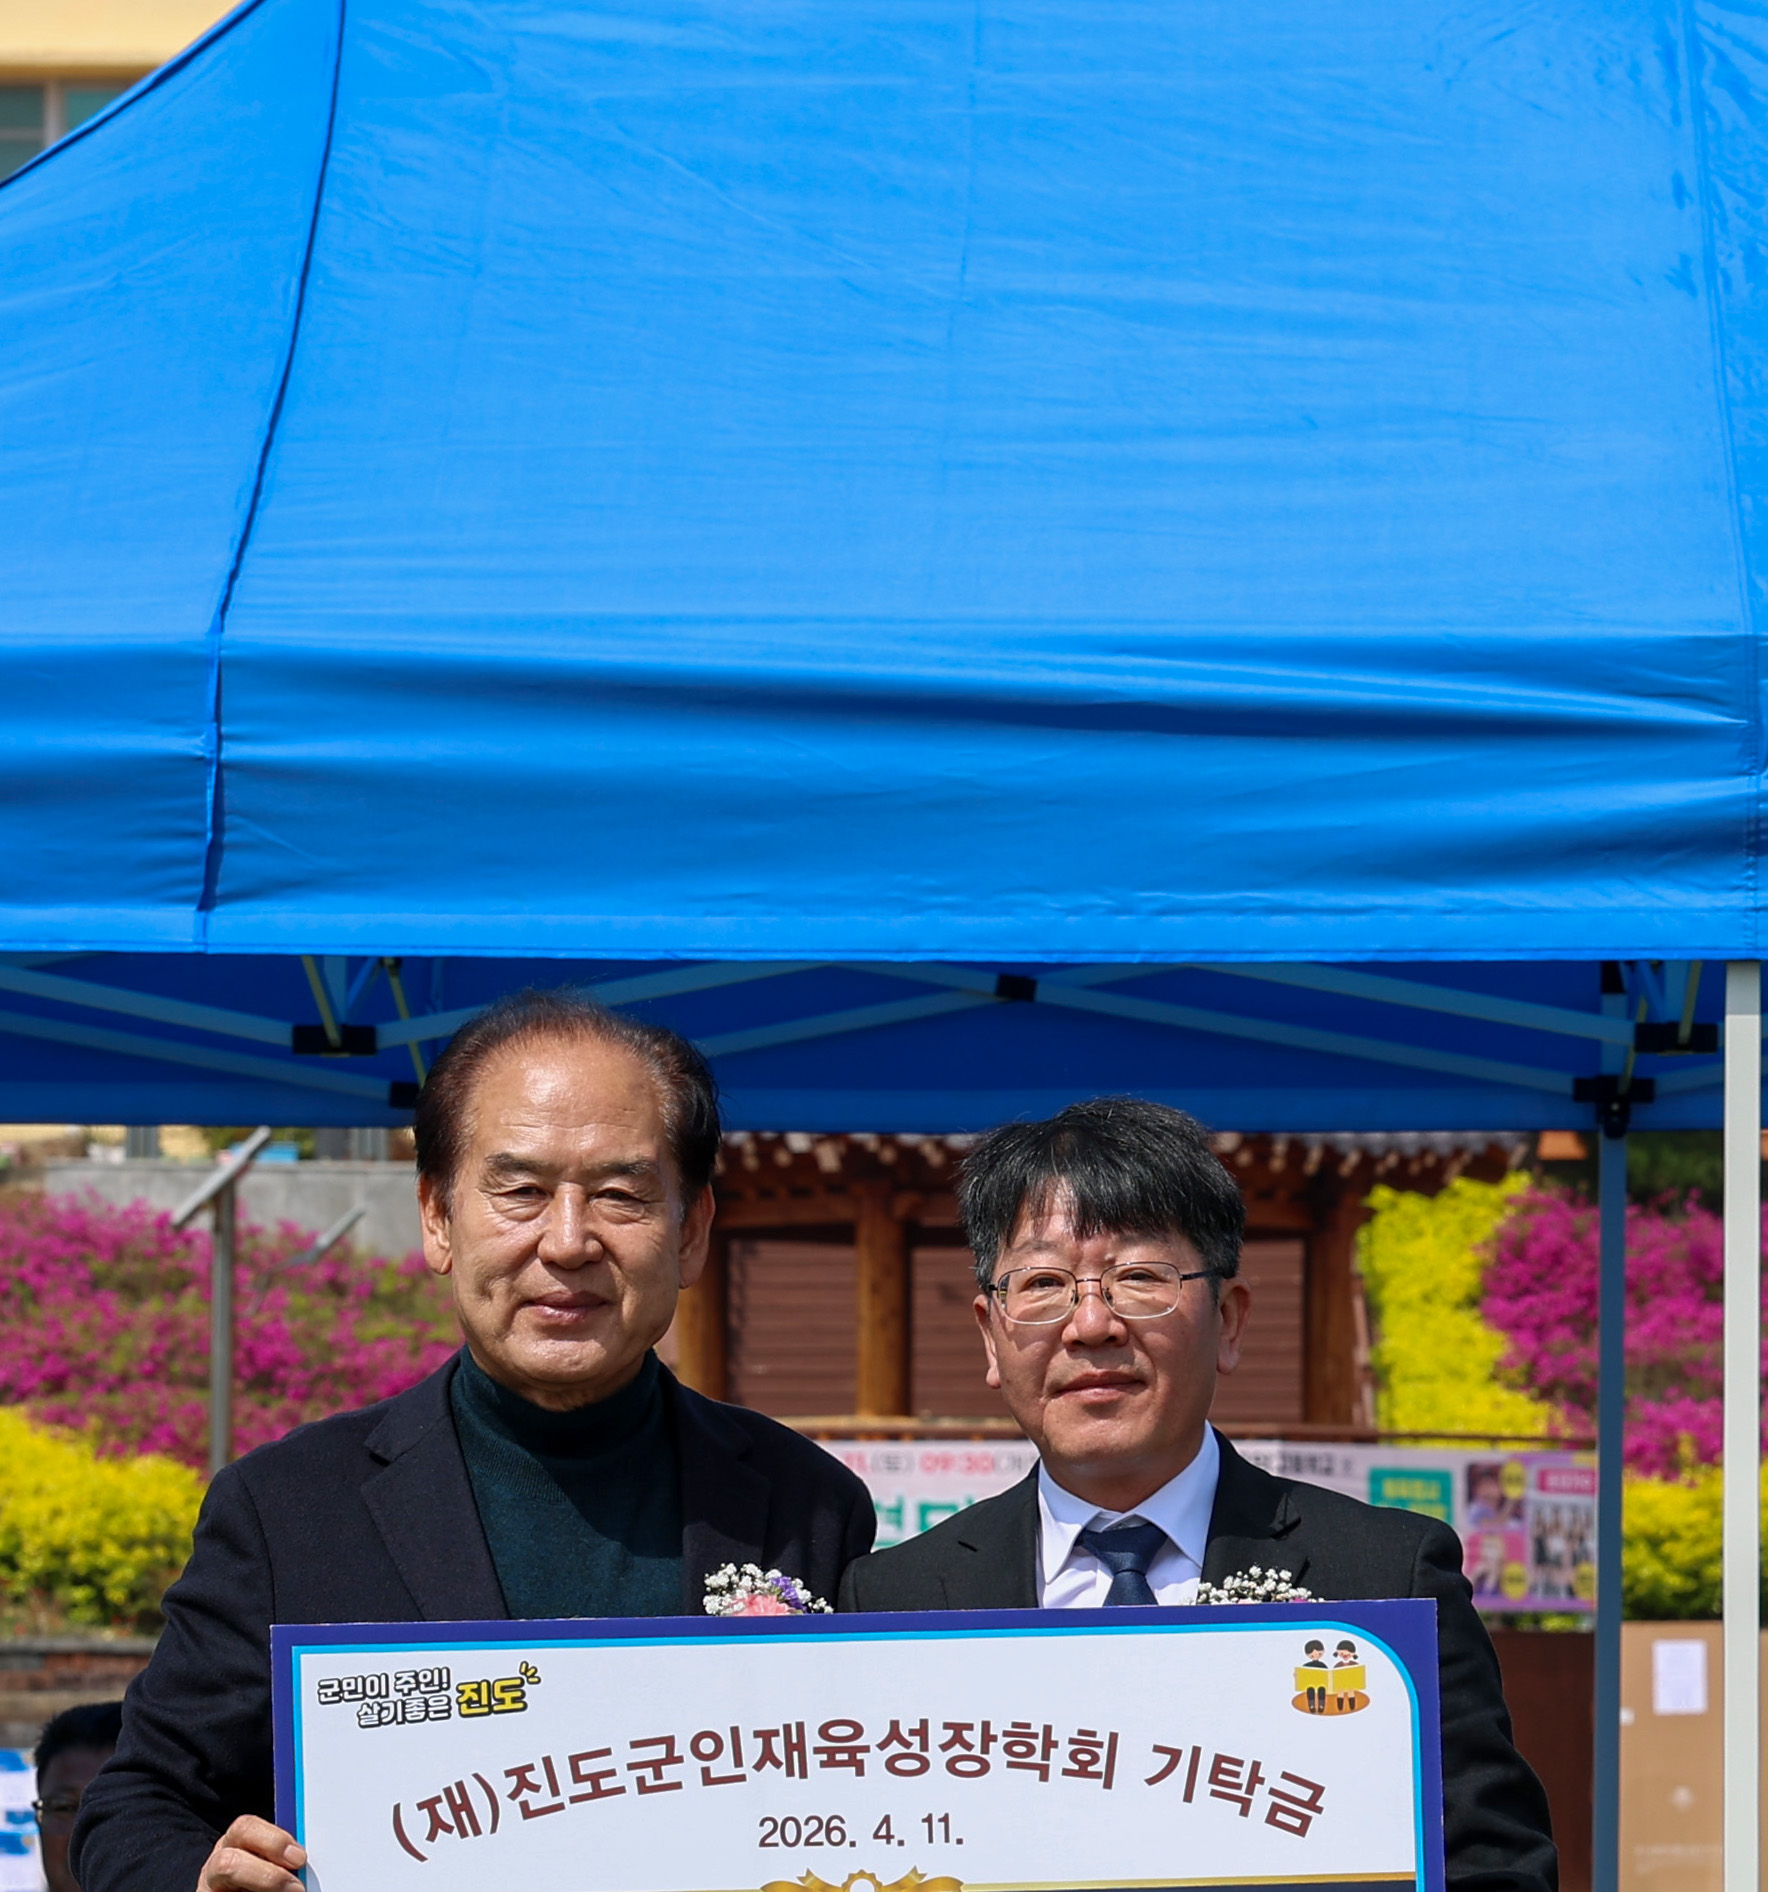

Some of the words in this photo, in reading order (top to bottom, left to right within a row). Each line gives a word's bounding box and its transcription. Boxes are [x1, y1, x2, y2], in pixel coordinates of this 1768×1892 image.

[318, 1673, 389, 1705] 군민이
[394, 1666, 451, 1697] 주인!
[357, 1694, 452, 1729] 살기좋은
[456, 1677, 528, 1718] 진도
[392, 1718, 1120, 1862] (재)진도군인재육성장학회
[1143, 1743, 1326, 1839] 기탁금
[758, 1815, 857, 1849] 2026.
[872, 1814, 905, 1847] 4.
[921, 1812, 964, 1845] 11.
